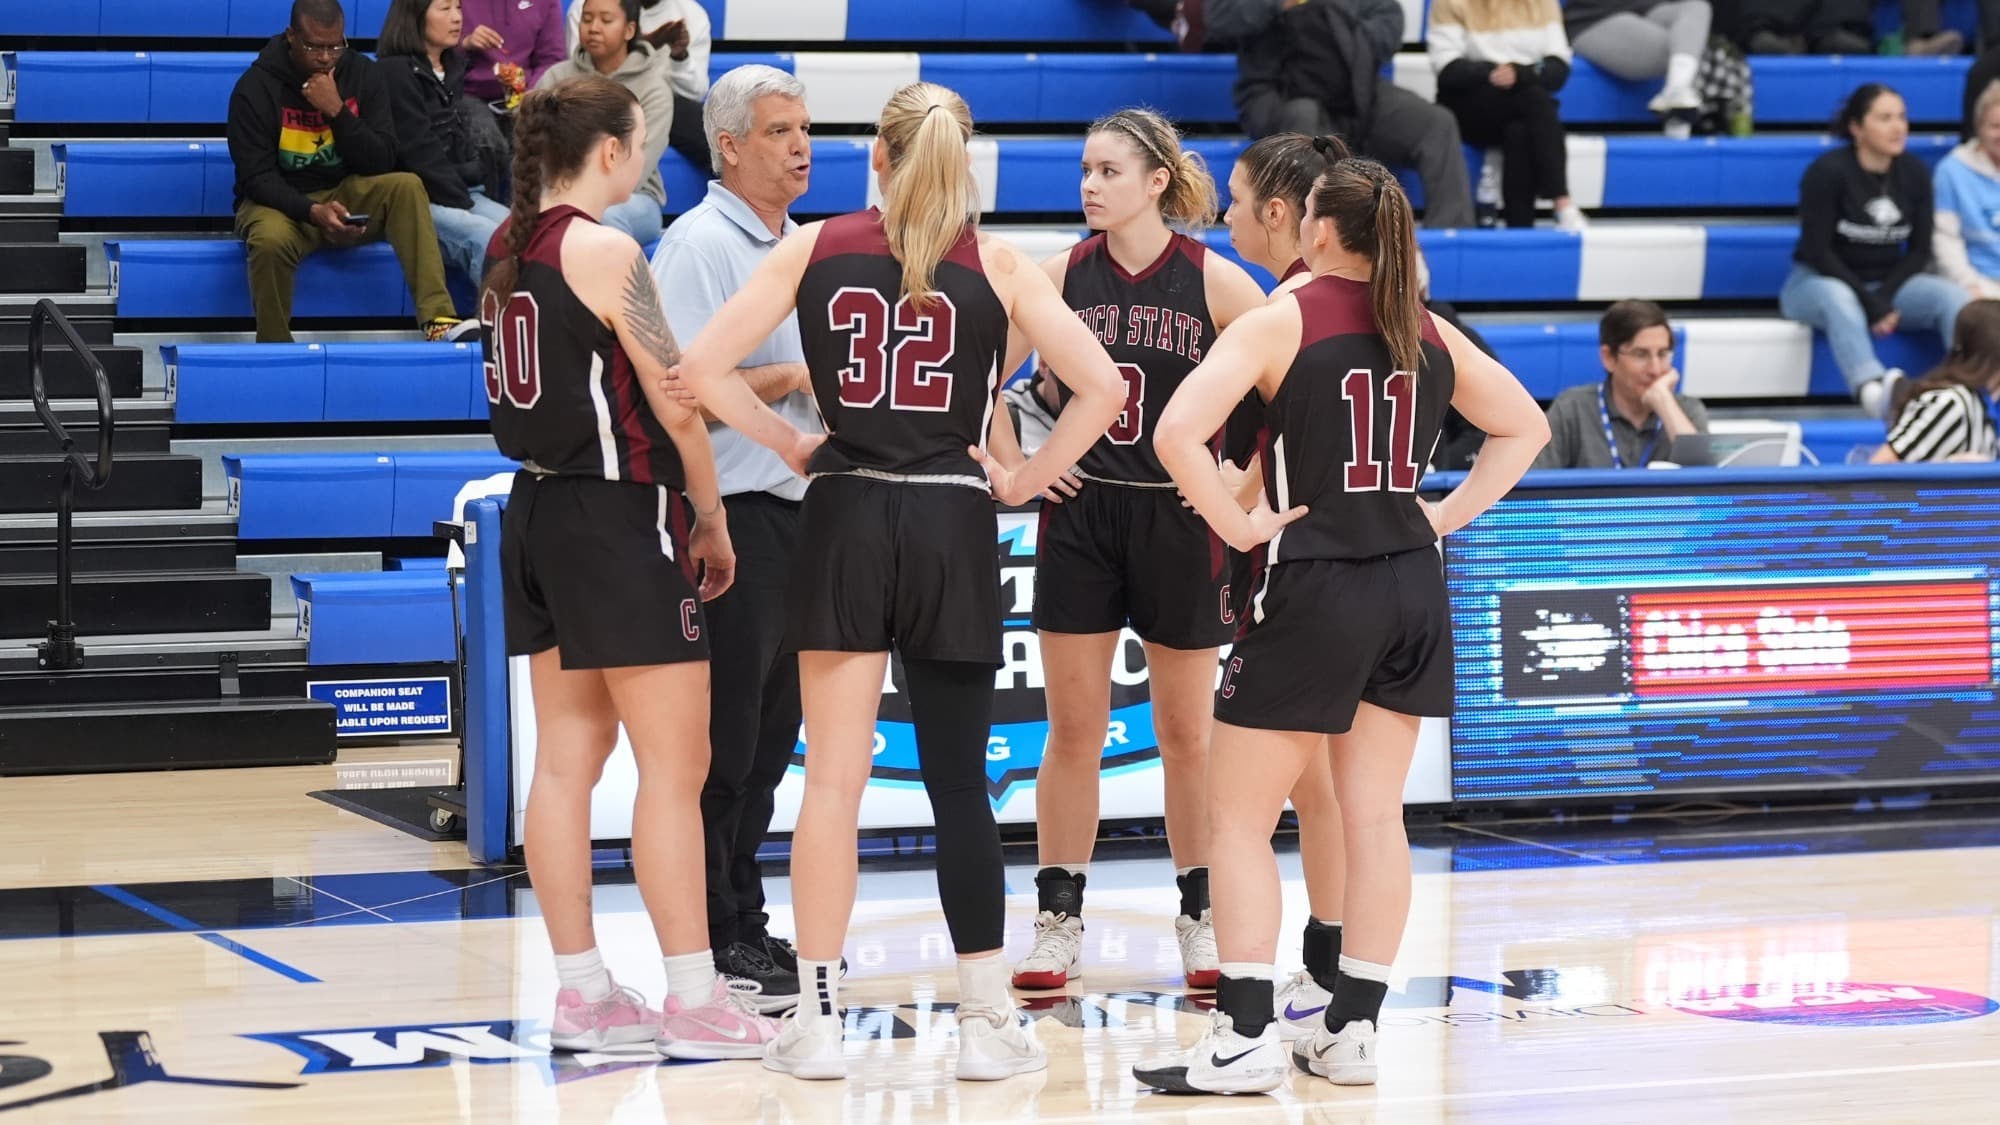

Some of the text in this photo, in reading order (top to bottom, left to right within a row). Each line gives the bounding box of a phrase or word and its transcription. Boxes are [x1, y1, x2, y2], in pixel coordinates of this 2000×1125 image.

[481, 287, 542, 409] 30
[828, 286, 956, 412] 32
[1127, 305, 1202, 363] STATE
[1341, 368, 1419, 492] 11
[680, 598, 700, 641] C
[335, 686, 424, 698] COMPANION SEAT
[1222, 656, 1243, 699] C
[336, 715, 447, 728] LABLE UPON REQUEST
[344, 702, 415, 713] WILL BE MADE
[1379, 1005, 1646, 1027] Divisio
